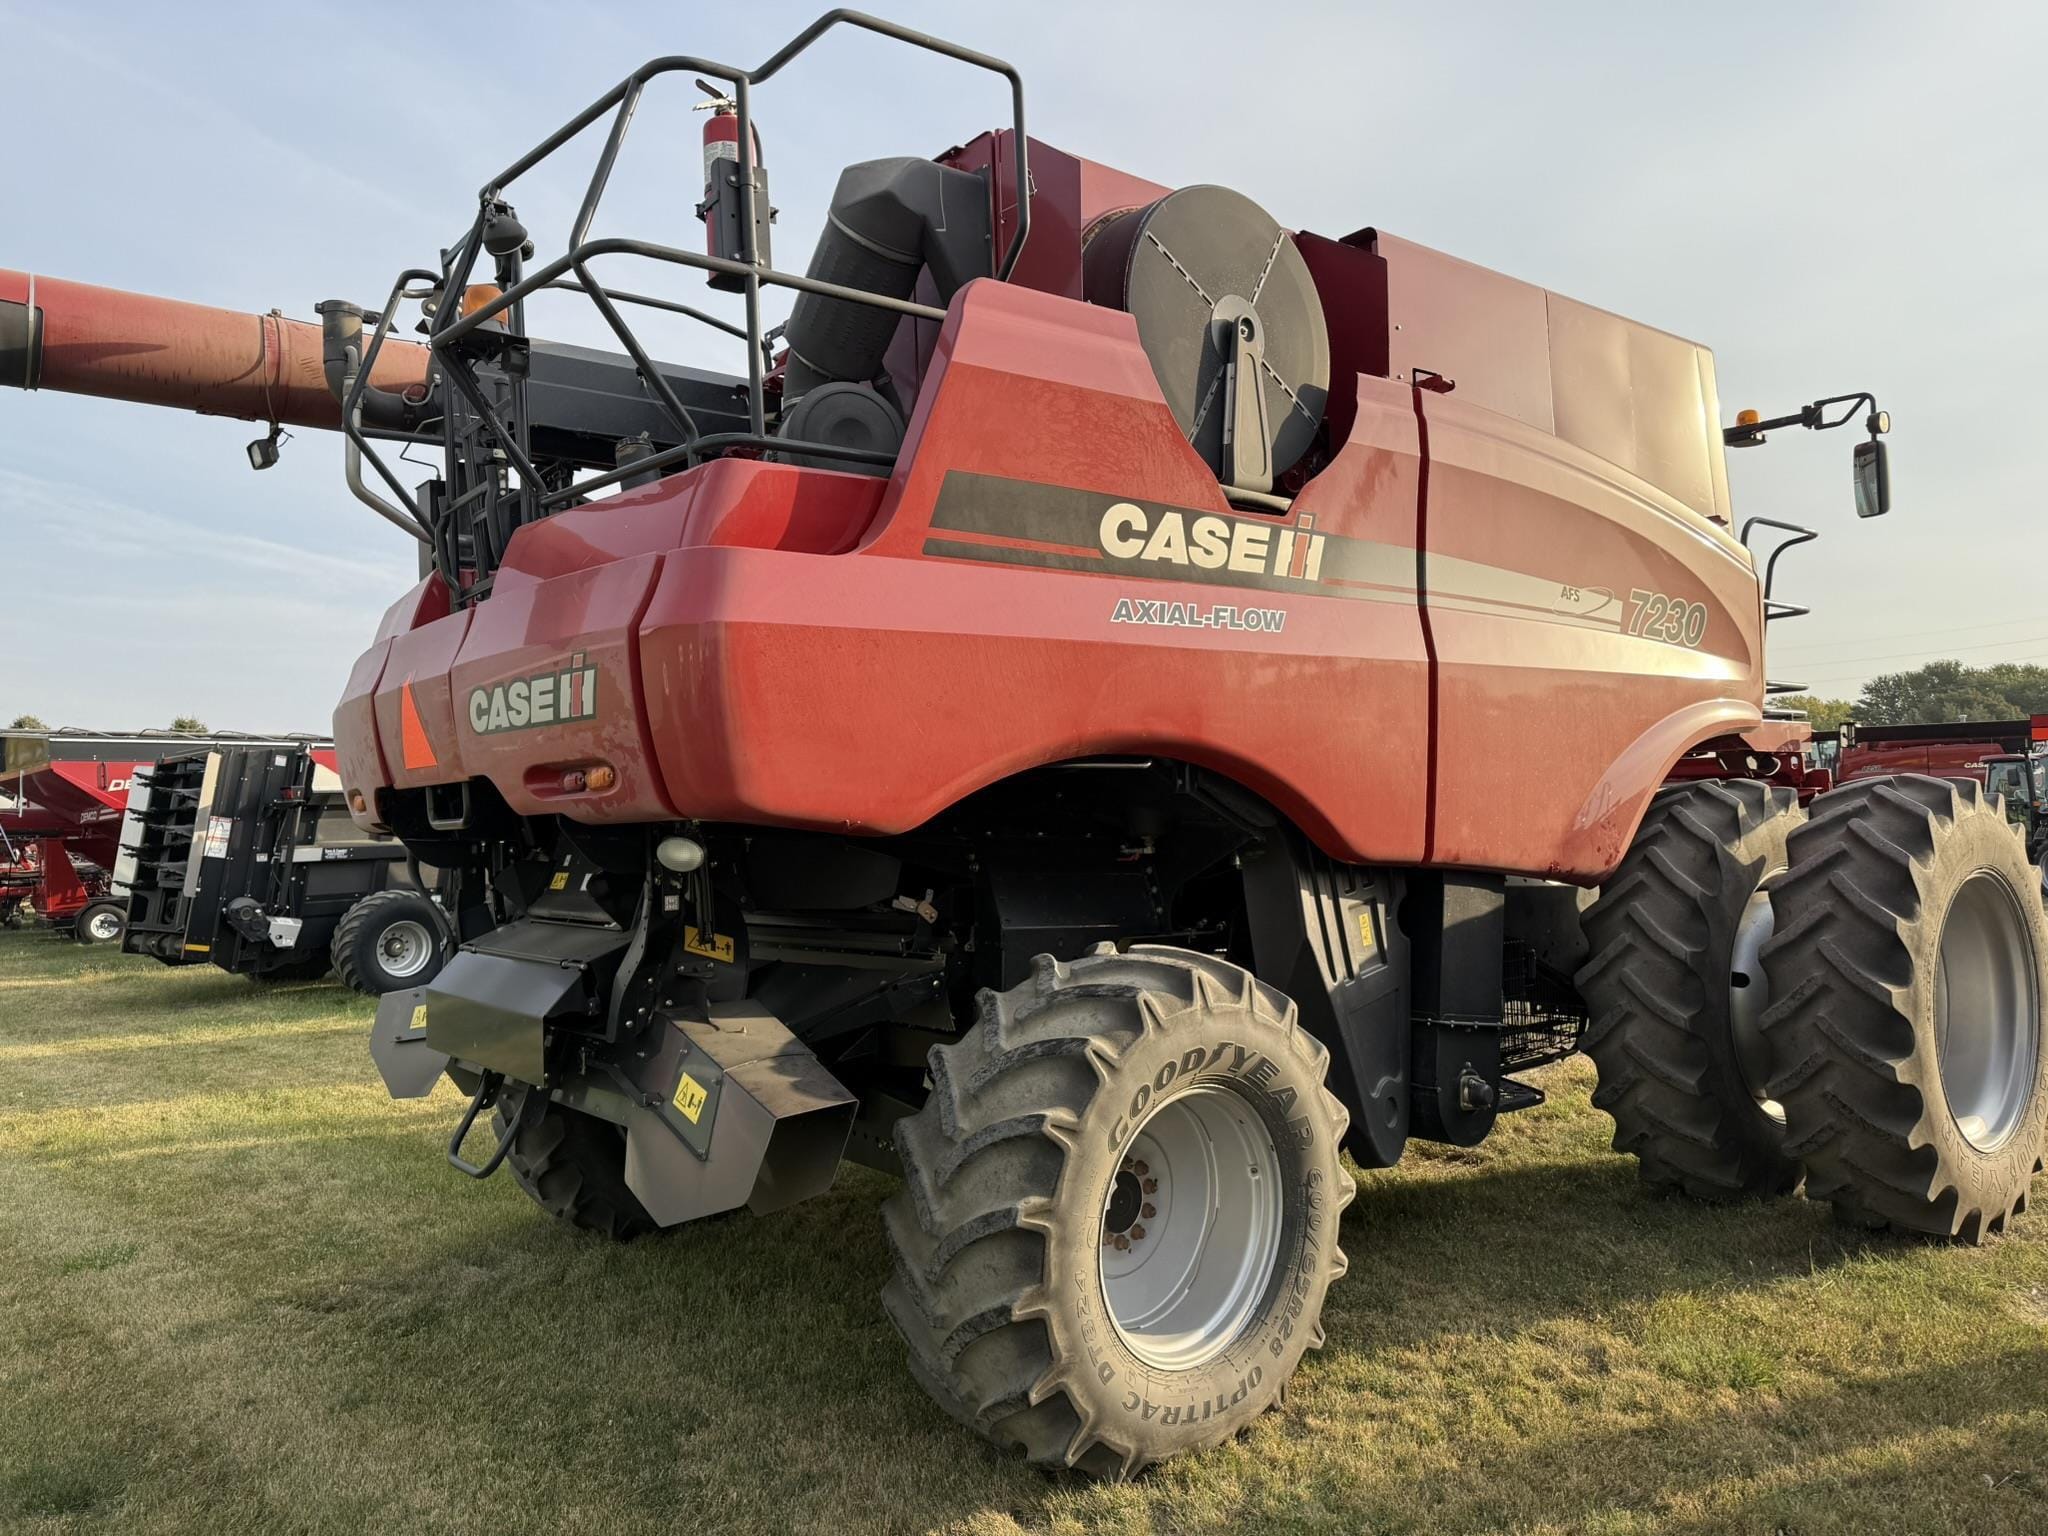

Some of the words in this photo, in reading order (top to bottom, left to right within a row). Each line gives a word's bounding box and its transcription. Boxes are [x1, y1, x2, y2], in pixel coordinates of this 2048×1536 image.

[1100, 503, 1271, 573] CASE
[1111, 598, 1286, 632] AXIAL-FLOW
[1561, 586, 1580, 602] AFS
[1627, 588, 1708, 647] 7230
[469, 676, 555, 734] CASE
[1108, 1040, 1314, 1153] GOODYEAR
[1269, 1167, 1323, 1359] 600/65R28
[1121, 1366, 1263, 1426] OPTITRAC
